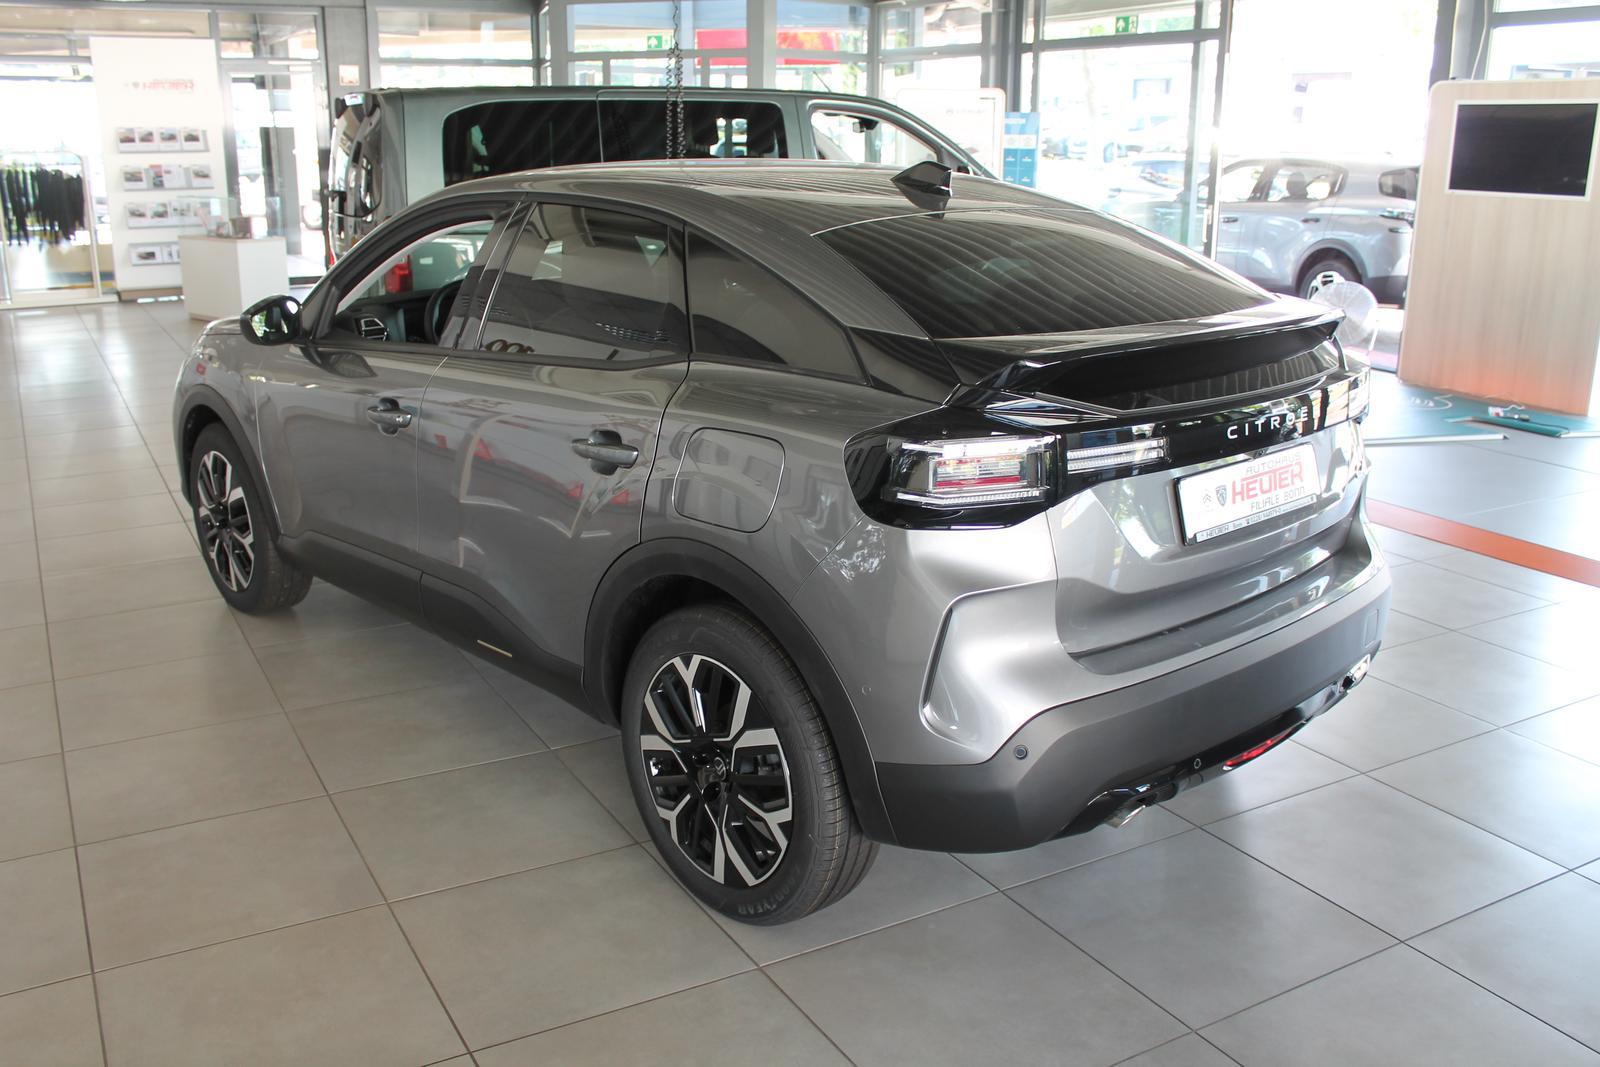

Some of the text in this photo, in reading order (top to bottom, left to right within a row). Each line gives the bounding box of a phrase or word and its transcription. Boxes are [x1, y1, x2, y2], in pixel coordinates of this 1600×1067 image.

[1246, 452, 1301, 475] AUTOHAUS
[1231, 461, 1305, 504] HEUTER
[1250, 494, 1280, 512] FILIALE
